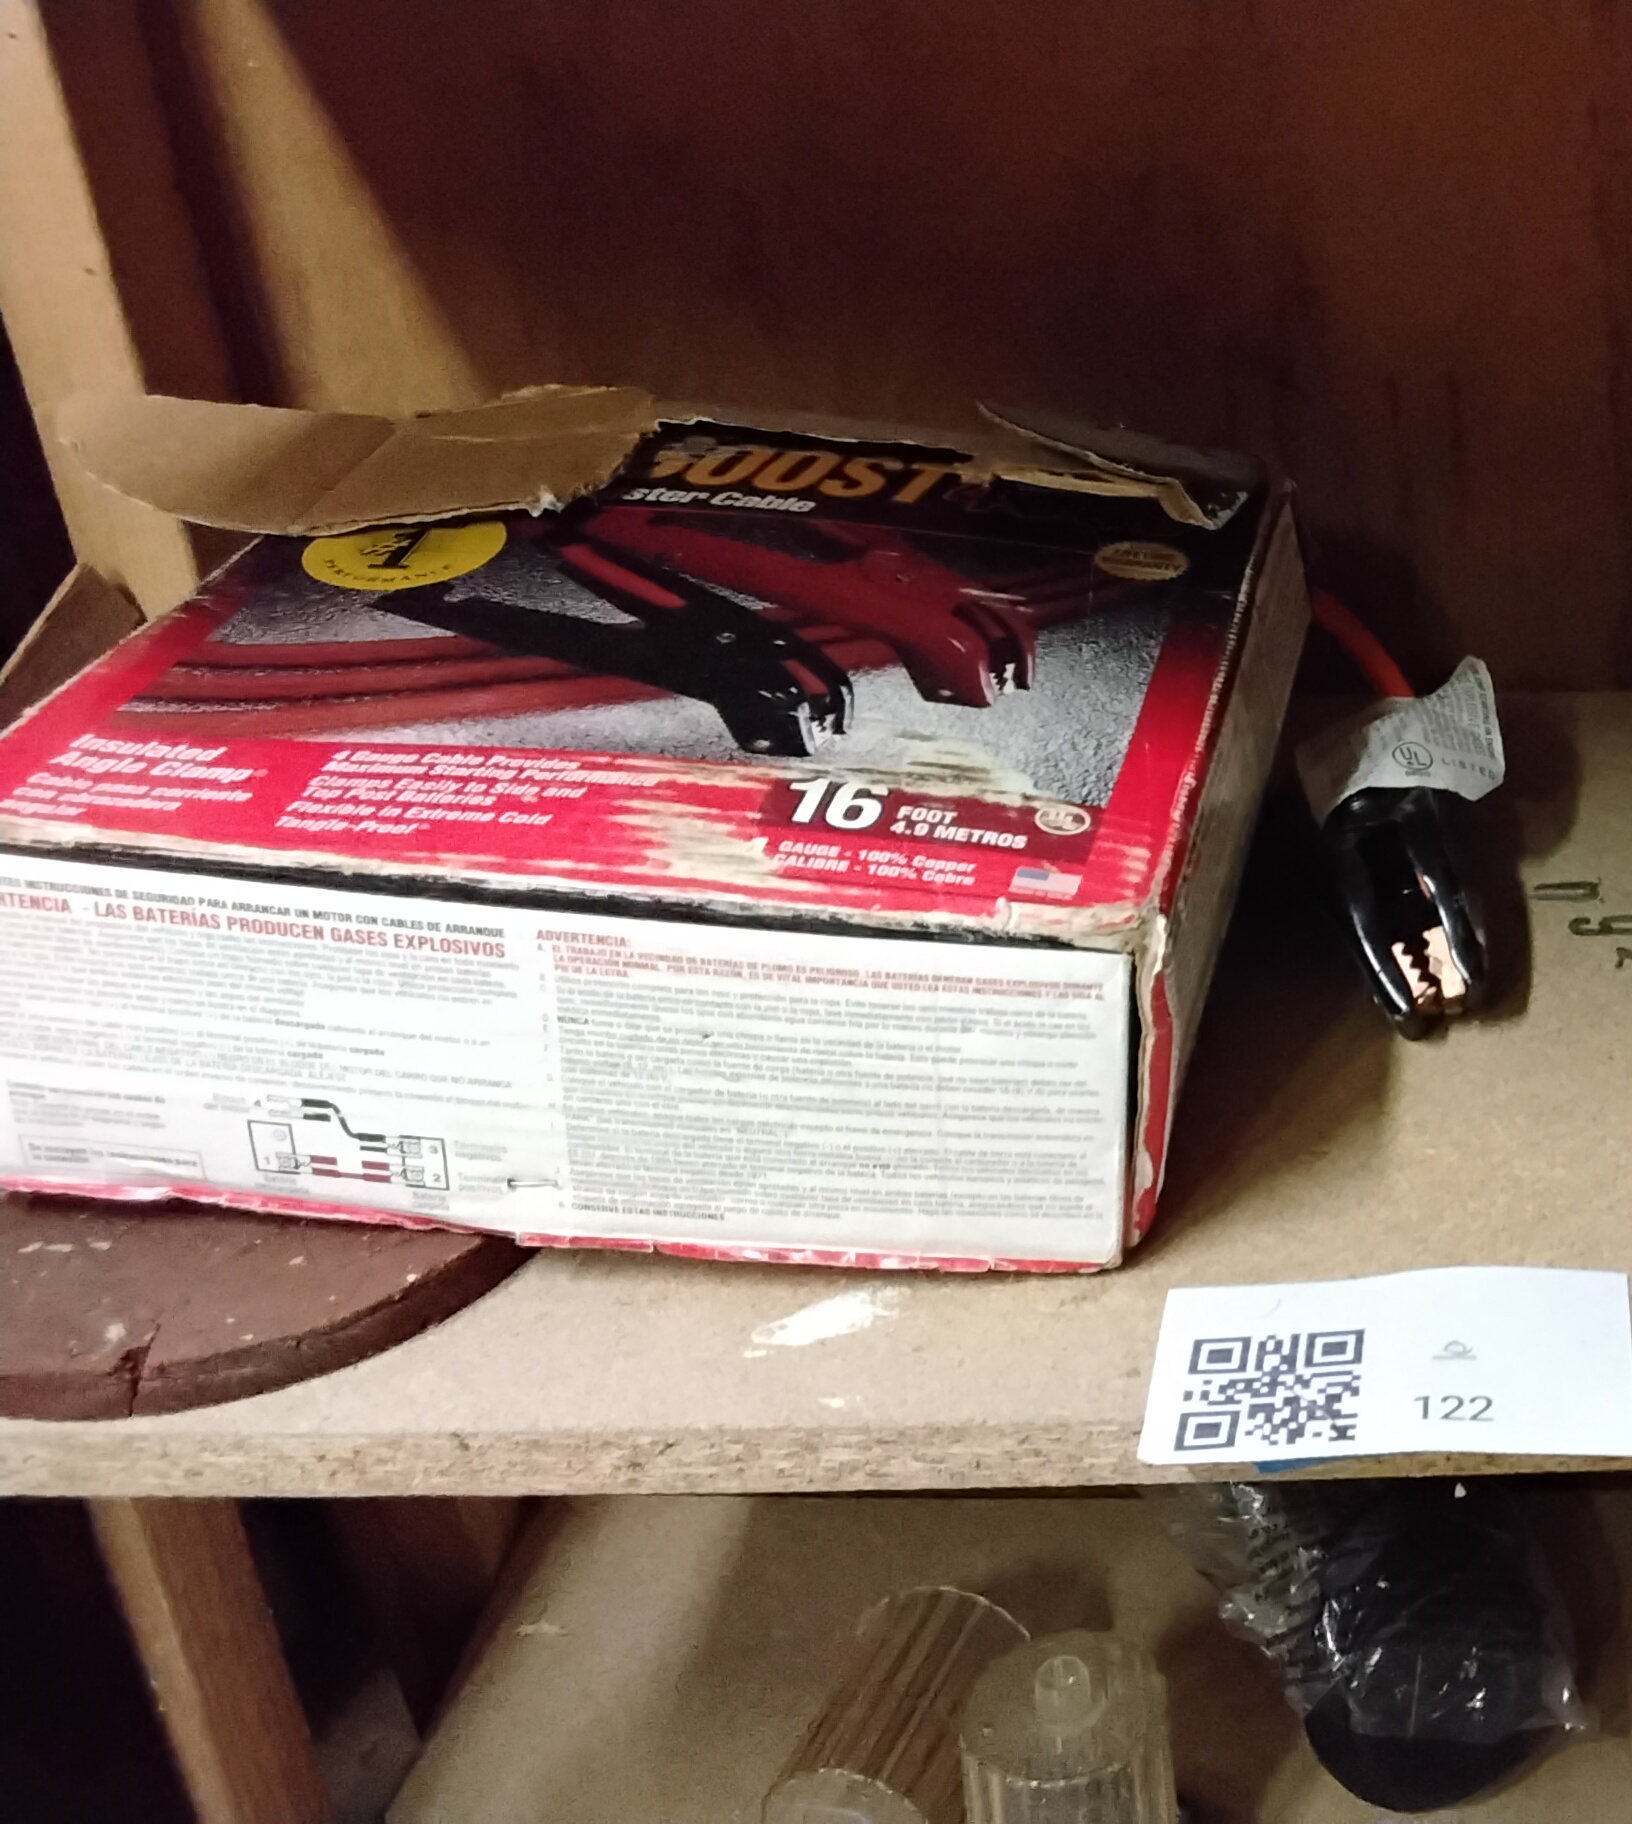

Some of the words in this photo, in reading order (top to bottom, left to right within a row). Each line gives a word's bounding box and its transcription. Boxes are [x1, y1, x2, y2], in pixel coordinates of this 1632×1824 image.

[711, 490, 817, 513] Cable
[70, 734, 229, 762] Insulated
[49, 751, 147, 774] Angle
[150, 762, 254, 783] Clamp
[321, 761, 427, 775] Maximum
[429, 764, 521, 781] Starting
[353, 751, 419, 763] Gauge
[420, 752, 484, 766] Cable
[486, 756, 582, 771] Provides
[1442, 757, 1496, 780] LISTED
[302, 786, 343, 800] Top
[345, 788, 393, 801] Post
[395, 791, 497, 805] Batteries
[309, 775, 393, 789] Clamps
[394, 778, 461, 794] Easily
[464, 781, 486, 793] to
[489, 782, 538, 797] Side
[543, 786, 587, 798] and
[285, 801, 376, 817] Flexible
[379, 806, 401, 817] in
[404, 808, 496, 823] Extreme
[498, 810, 553, 825] Cold
[789, 779, 889, 829] 16
[896, 806, 957, 825] FOOT
[890, 823, 928, 837] 4.9
[933, 826, 1029, 850] METROS
[778, 841, 839, 858] GAUGE
[858, 850, 908, 866] 100%
[913, 855, 977, 873] Copper
[772, 855, 849, 872] CALIBRE
[867, 863, 917, 880] 100%
[922, 869, 975, 886] Cobre
[115, 888, 127, 899] DE
[132, 890, 195, 906] SEGURIDAD
[198, 897, 227, 909] PARA
[231, 900, 290, 916] ARRANCAR
[295, 908, 308, 918] UN
[312, 909, 352, 923] MOTOR
[355, 914, 378, 925] CON
[381, 916, 423, 930] CABLES
[427, 921, 440, 932] DE
[445, 922, 505, 939] ARRANQUE
[94, 900, 127, 920] LAS
[133, 901, 220, 931] BATERÍAS
[226, 915, 324, 941] PRODUCEN
[330, 925, 387, 947] GASES
[393, 931, 505, 959] EXPLOSIVOS
[536, 929, 631, 948] ADVERTENCIA:
[1413, 1394, 1495, 1422] 122
